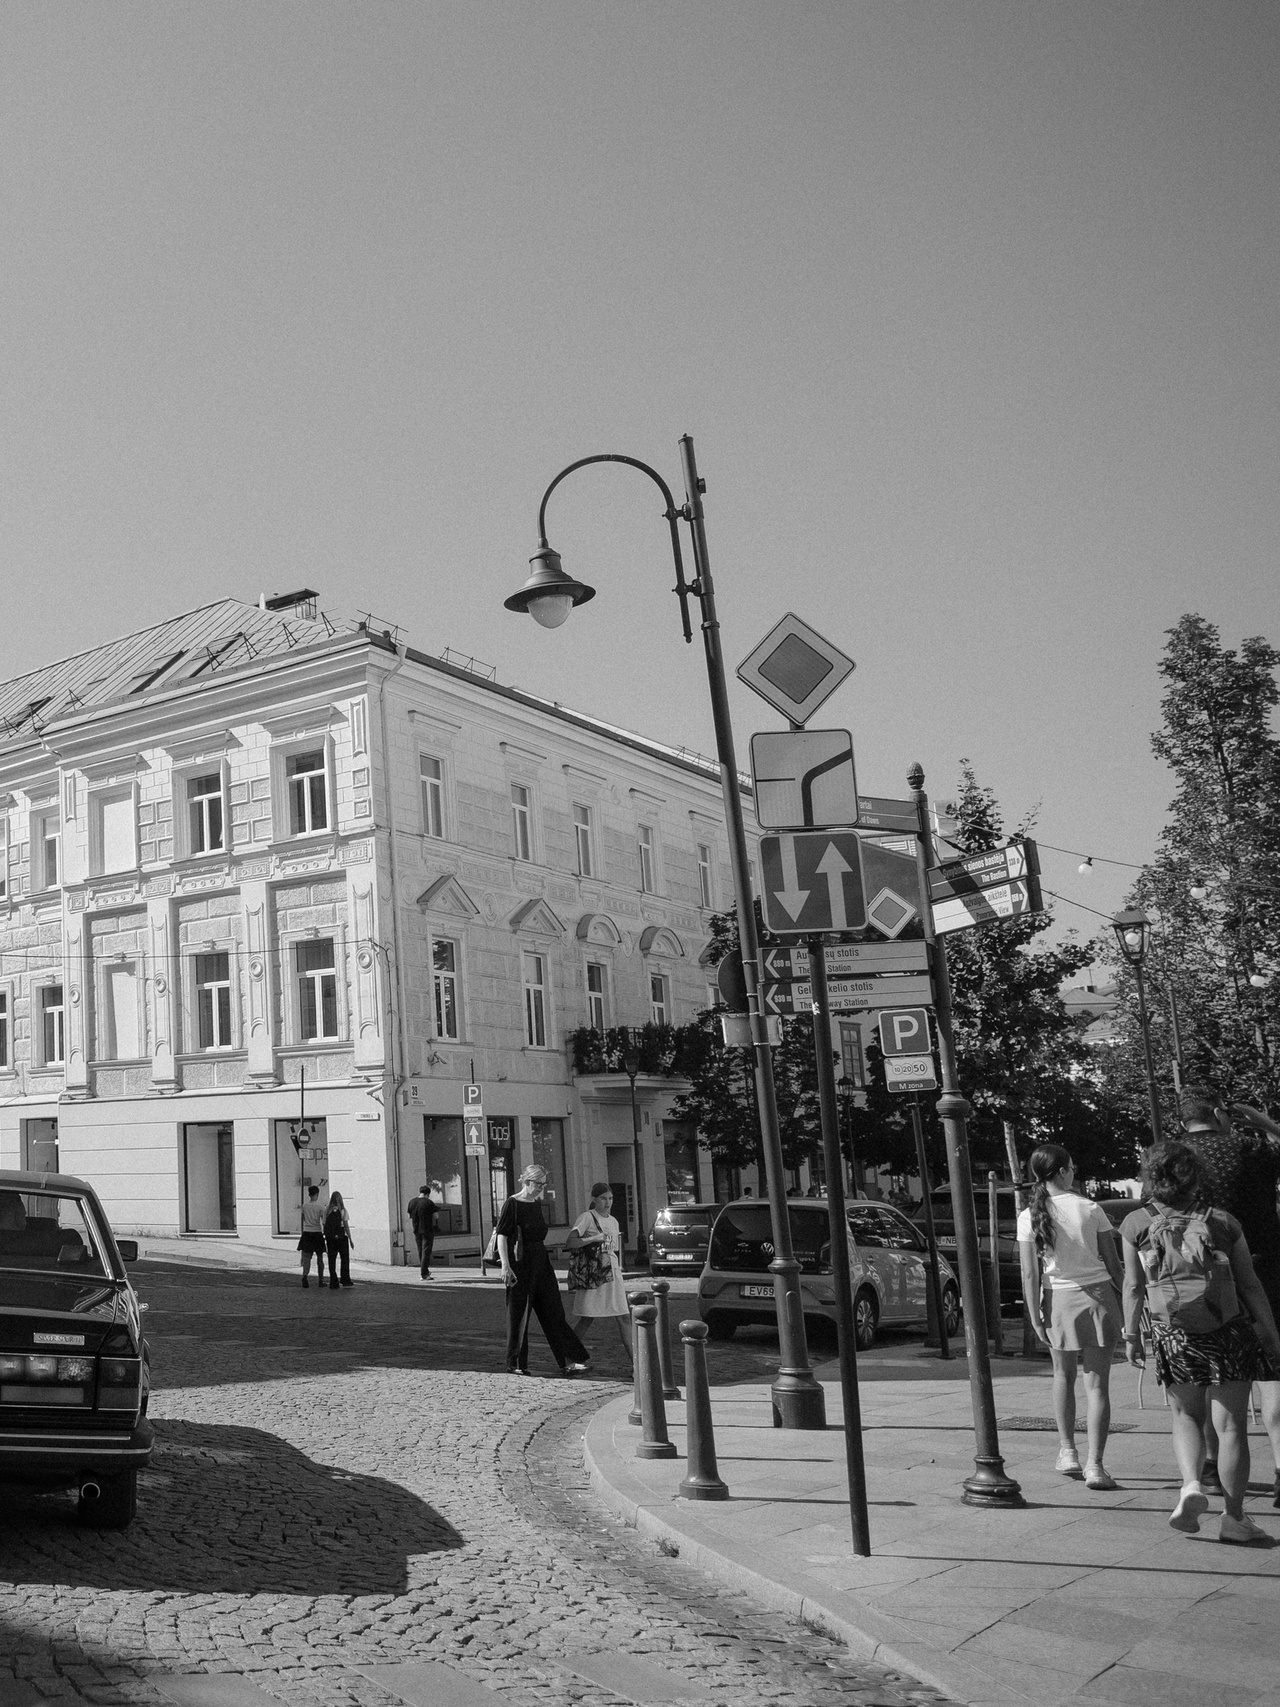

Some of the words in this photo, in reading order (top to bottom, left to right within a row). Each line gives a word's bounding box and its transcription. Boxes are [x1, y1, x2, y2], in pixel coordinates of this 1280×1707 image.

[967, 858, 985, 872] sienos
[984, 852, 1006, 868] bastėja
[980, 873, 991, 883] The
[990, 868, 1007, 881] Bastion
[998, 904, 1010, 915] View
[796, 949, 836, 961] Ausų
[836, 947, 860, 958] stotis
[798, 965, 811, 975] The
[827, 964, 853, 974] Station
[797, 982, 850, 996] Gelkelio
[850, 981, 874, 993] stotis
[799, 1001, 813, 1010] The
[843, 998, 869, 1007] Station
[892, 1015, 919, 1050] P
[913, 1063, 925, 1073] 50
[907, 1082, 924, 1090] zona
[468, 1086, 479, 1104] P
[749, 1286, 776, 1297] EV69
